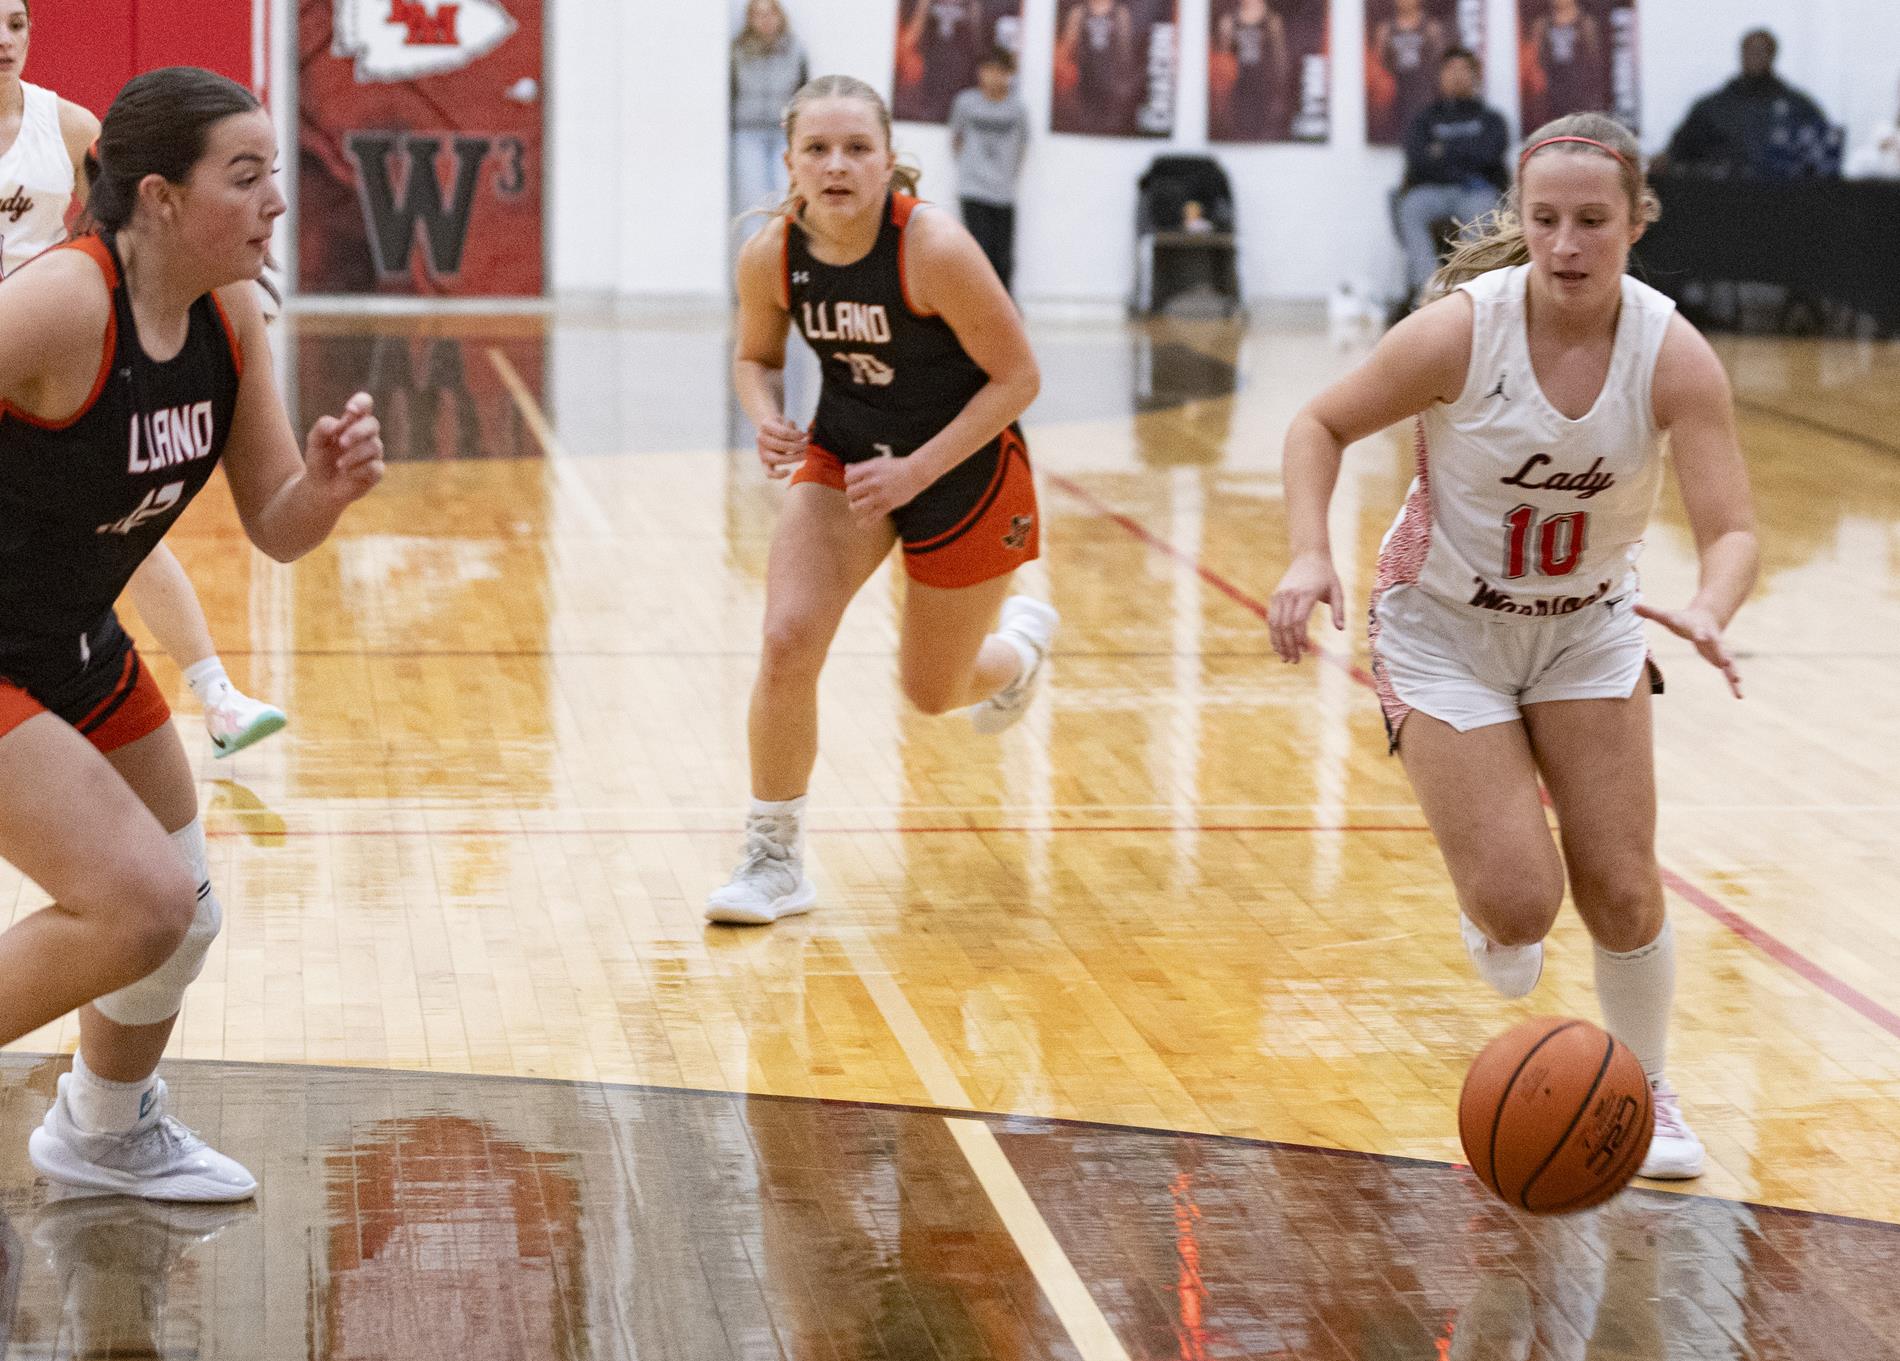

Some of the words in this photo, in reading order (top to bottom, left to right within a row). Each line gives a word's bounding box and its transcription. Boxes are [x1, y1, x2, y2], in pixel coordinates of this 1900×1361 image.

[801, 300, 892, 344] LLANO
[127, 400, 214, 473] LLANO
[1500, 453, 1615, 499] Lady
[1501, 503, 1592, 580] 10
